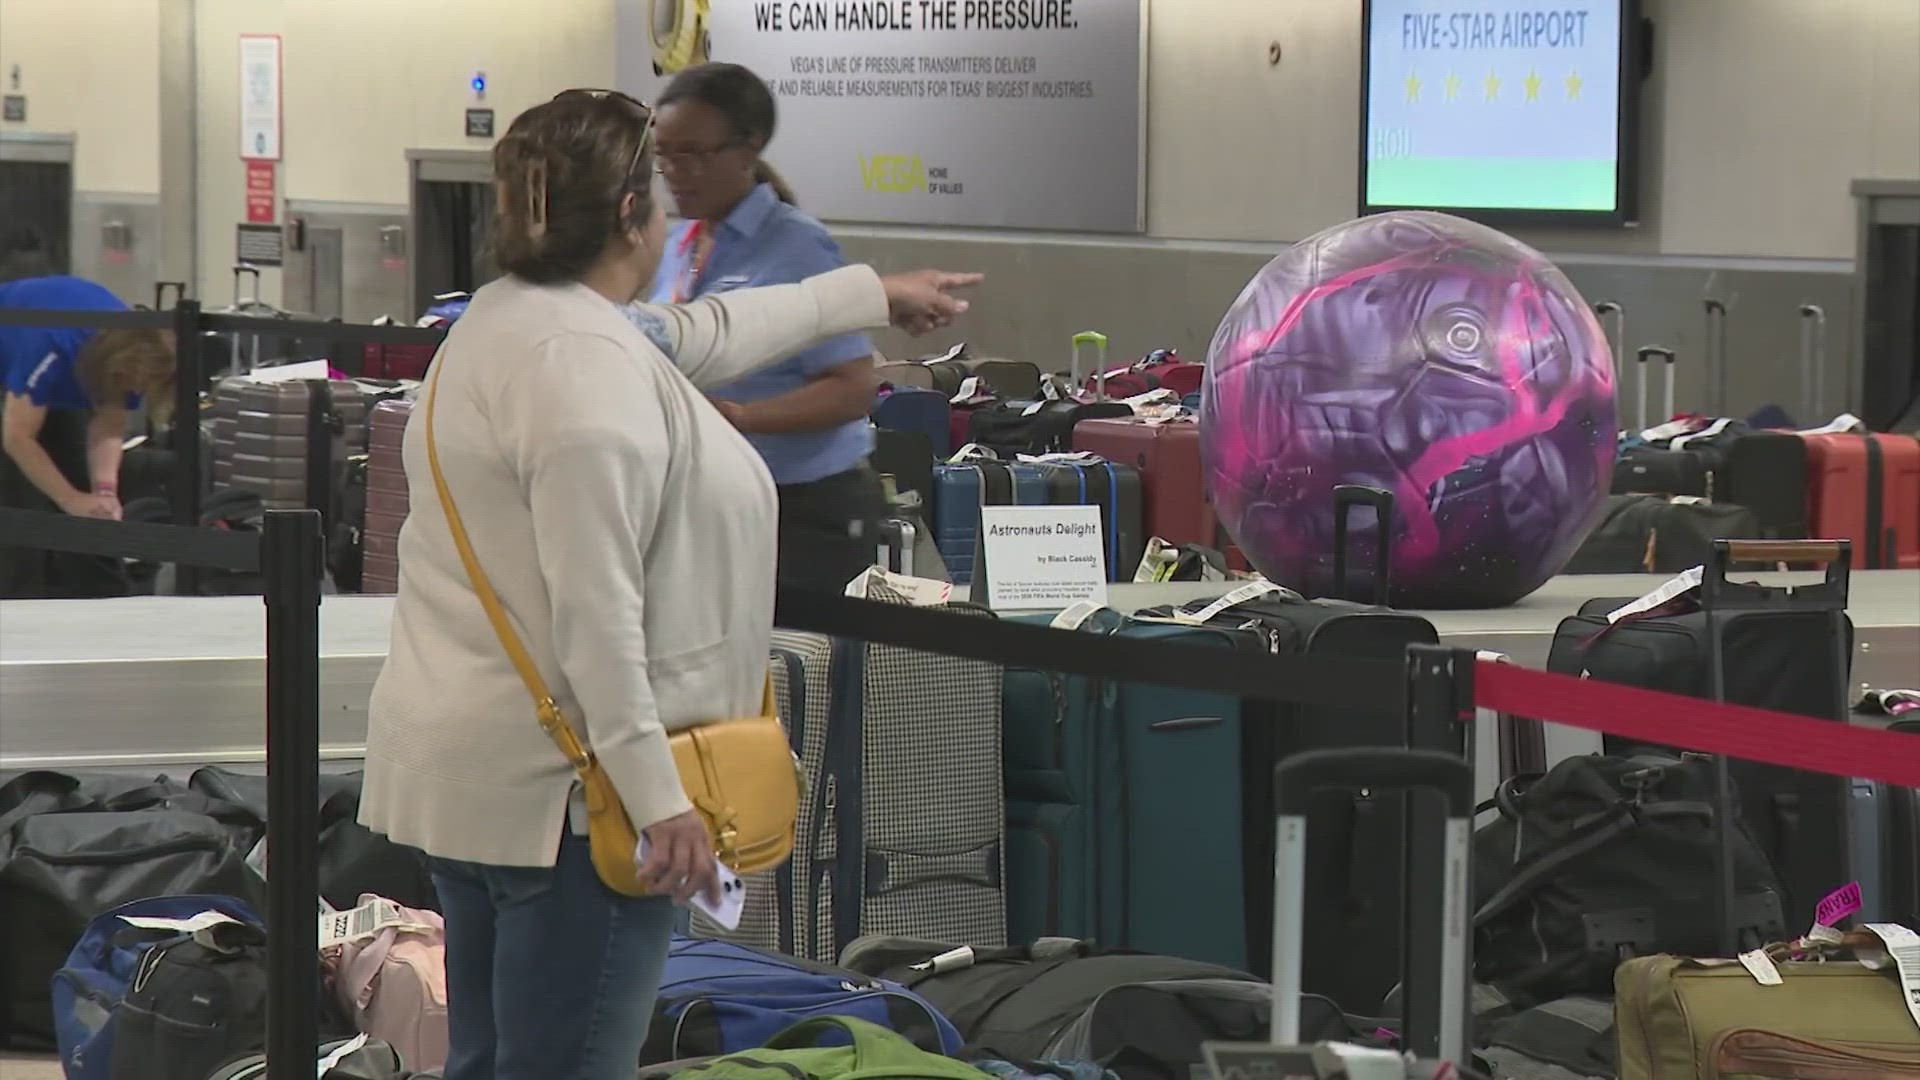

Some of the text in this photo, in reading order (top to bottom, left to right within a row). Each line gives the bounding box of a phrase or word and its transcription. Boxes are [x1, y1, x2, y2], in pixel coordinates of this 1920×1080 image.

[755, 0, 1078, 31] WE CAN HANDLE THE PRESSURE.
[1402, 10, 1589, 50] FIVE-STAR AIRPORT
[790, 56, 1036, 74] VEGA'S LINE OF PRESSURE TRANSMITTERS DELIVER
[778, 79, 798, 96] AND
[800, 80, 844, 96] RELIABLE
[846, 80, 925, 97] MEASUREMENTS
[927, 80, 947, 97] FOR
[950, 80, 984, 97] TEXAS'
[986, 80, 1029, 98] BIGGEST
[857, 154, 927, 192] VEGA
[989, 522, 1097, 538] Astronauts Delight
